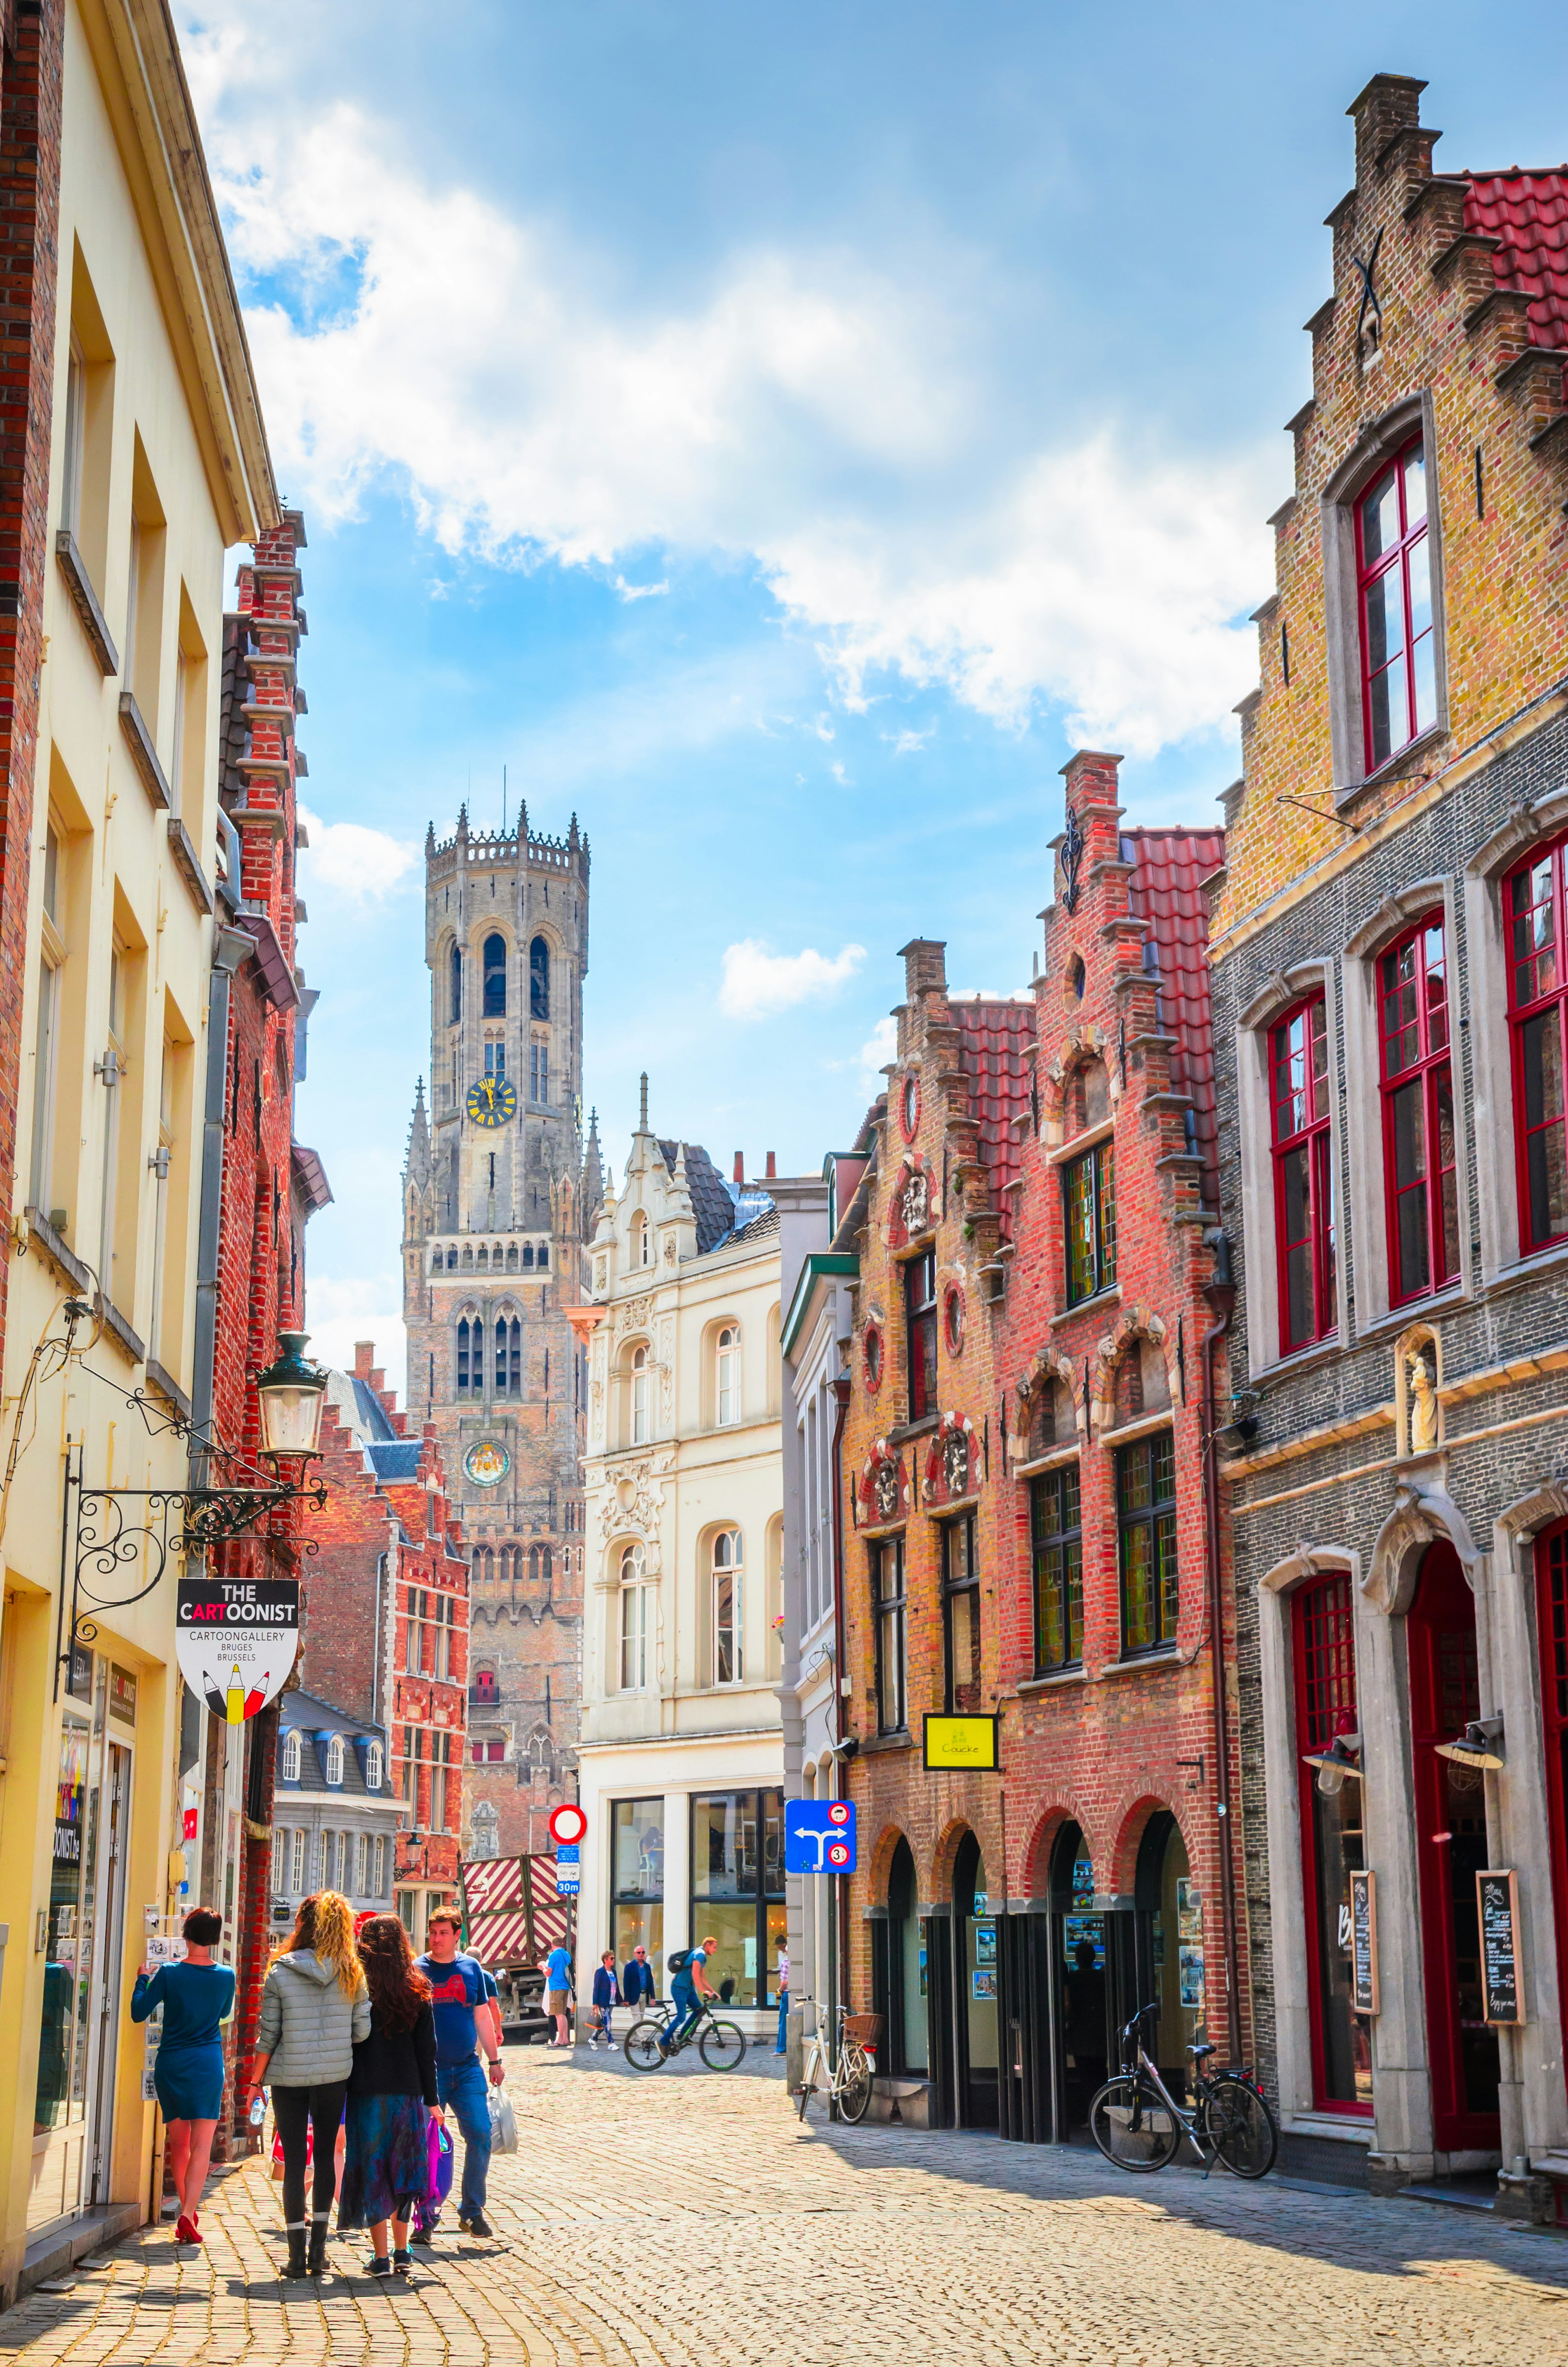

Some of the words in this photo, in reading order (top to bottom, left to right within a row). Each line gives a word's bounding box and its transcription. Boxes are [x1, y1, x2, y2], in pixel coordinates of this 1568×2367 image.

[221, 1585, 256, 1602] THE
[180, 1603, 295, 1621] CARTOONIST
[190, 1632, 285, 1641] CARTOONGALLERY
[942, 1744, 979, 1753] Coucke
[833, 1849, 840, 1860] 3
[558, 1883, 578, 1891] 30m
